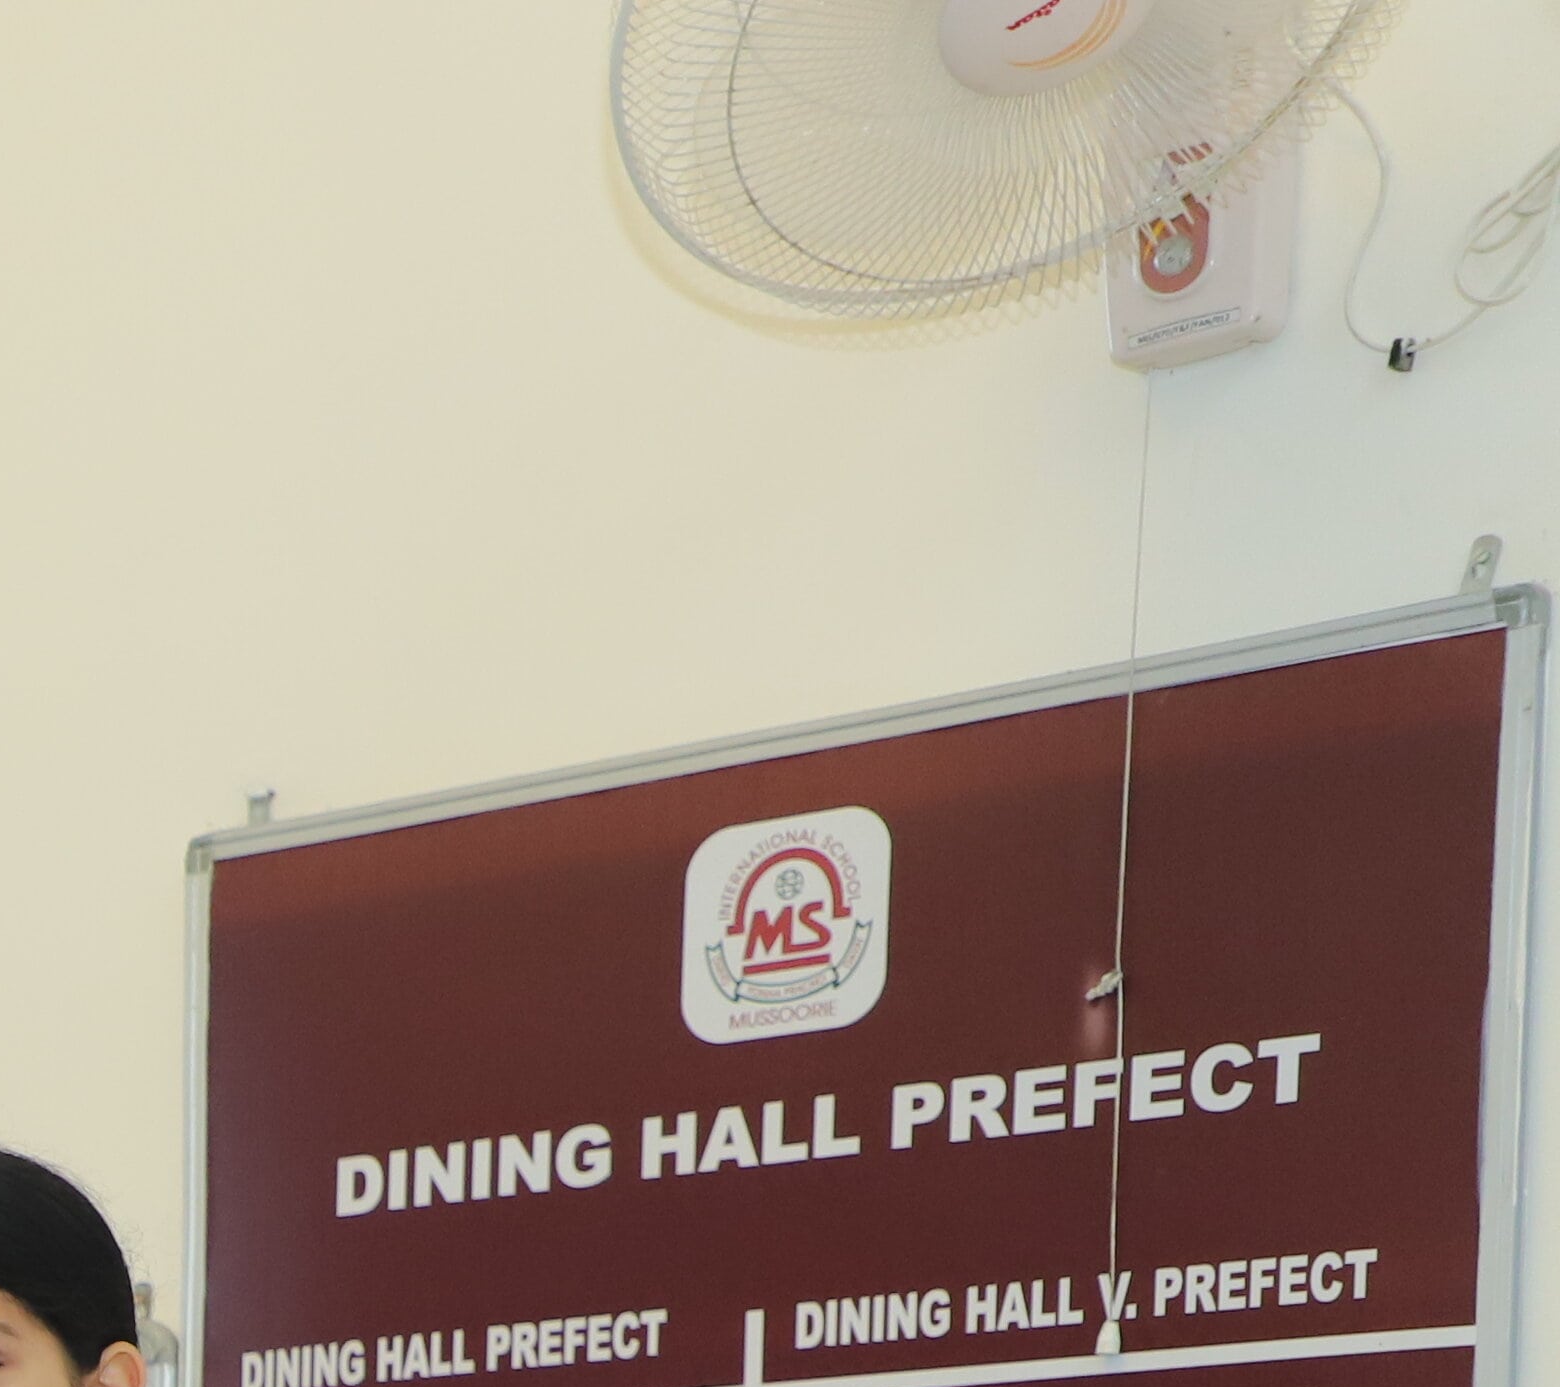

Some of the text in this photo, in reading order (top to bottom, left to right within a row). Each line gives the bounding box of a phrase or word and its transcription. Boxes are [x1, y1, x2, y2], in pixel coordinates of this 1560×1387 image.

[718, 827, 862, 921] INTERNATIONAL SCHOOL
[728, 1000, 838, 1030] MUSSOORIE
[337, 1033, 1320, 1216] DINING HALL PREFECT
[377, 1330, 474, 1381] HALL
[487, 1309, 666, 1371] PREFECT
[796, 1290, 950, 1349] DINING
[966, 1278, 1083, 1333] HALL
[1155, 1249, 1377, 1316] PREFECT
